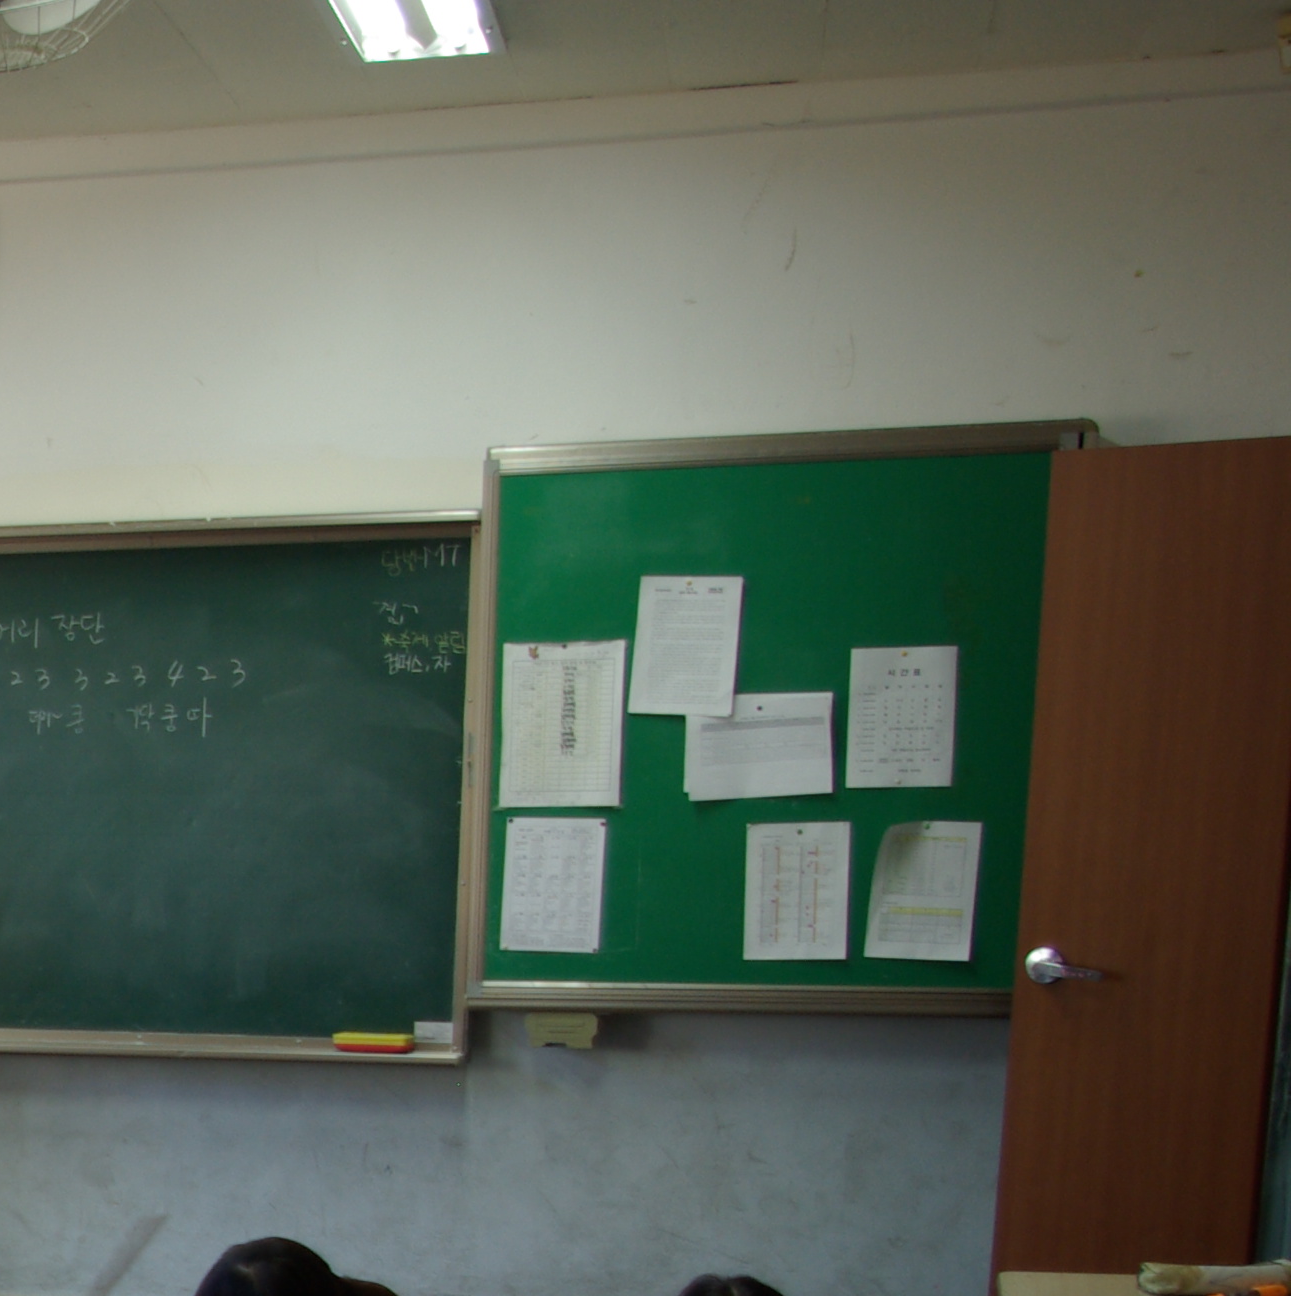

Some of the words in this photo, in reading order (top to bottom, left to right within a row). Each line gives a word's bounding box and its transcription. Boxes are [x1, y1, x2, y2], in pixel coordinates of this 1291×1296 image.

[50, 611, 106, 645] 장단
[9, 670, 25, 687] 2
[34, 667, 51, 690] 3
[73, 668, 90, 691] 3
[104, 670, 120, 686] 2
[131, 664, 148, 687] 3
[167, 659, 185, 688] 4
[196, 665, 218, 681] 2
[229, 658, 247, 688] 3
[431, 654, 453, 674] 자
